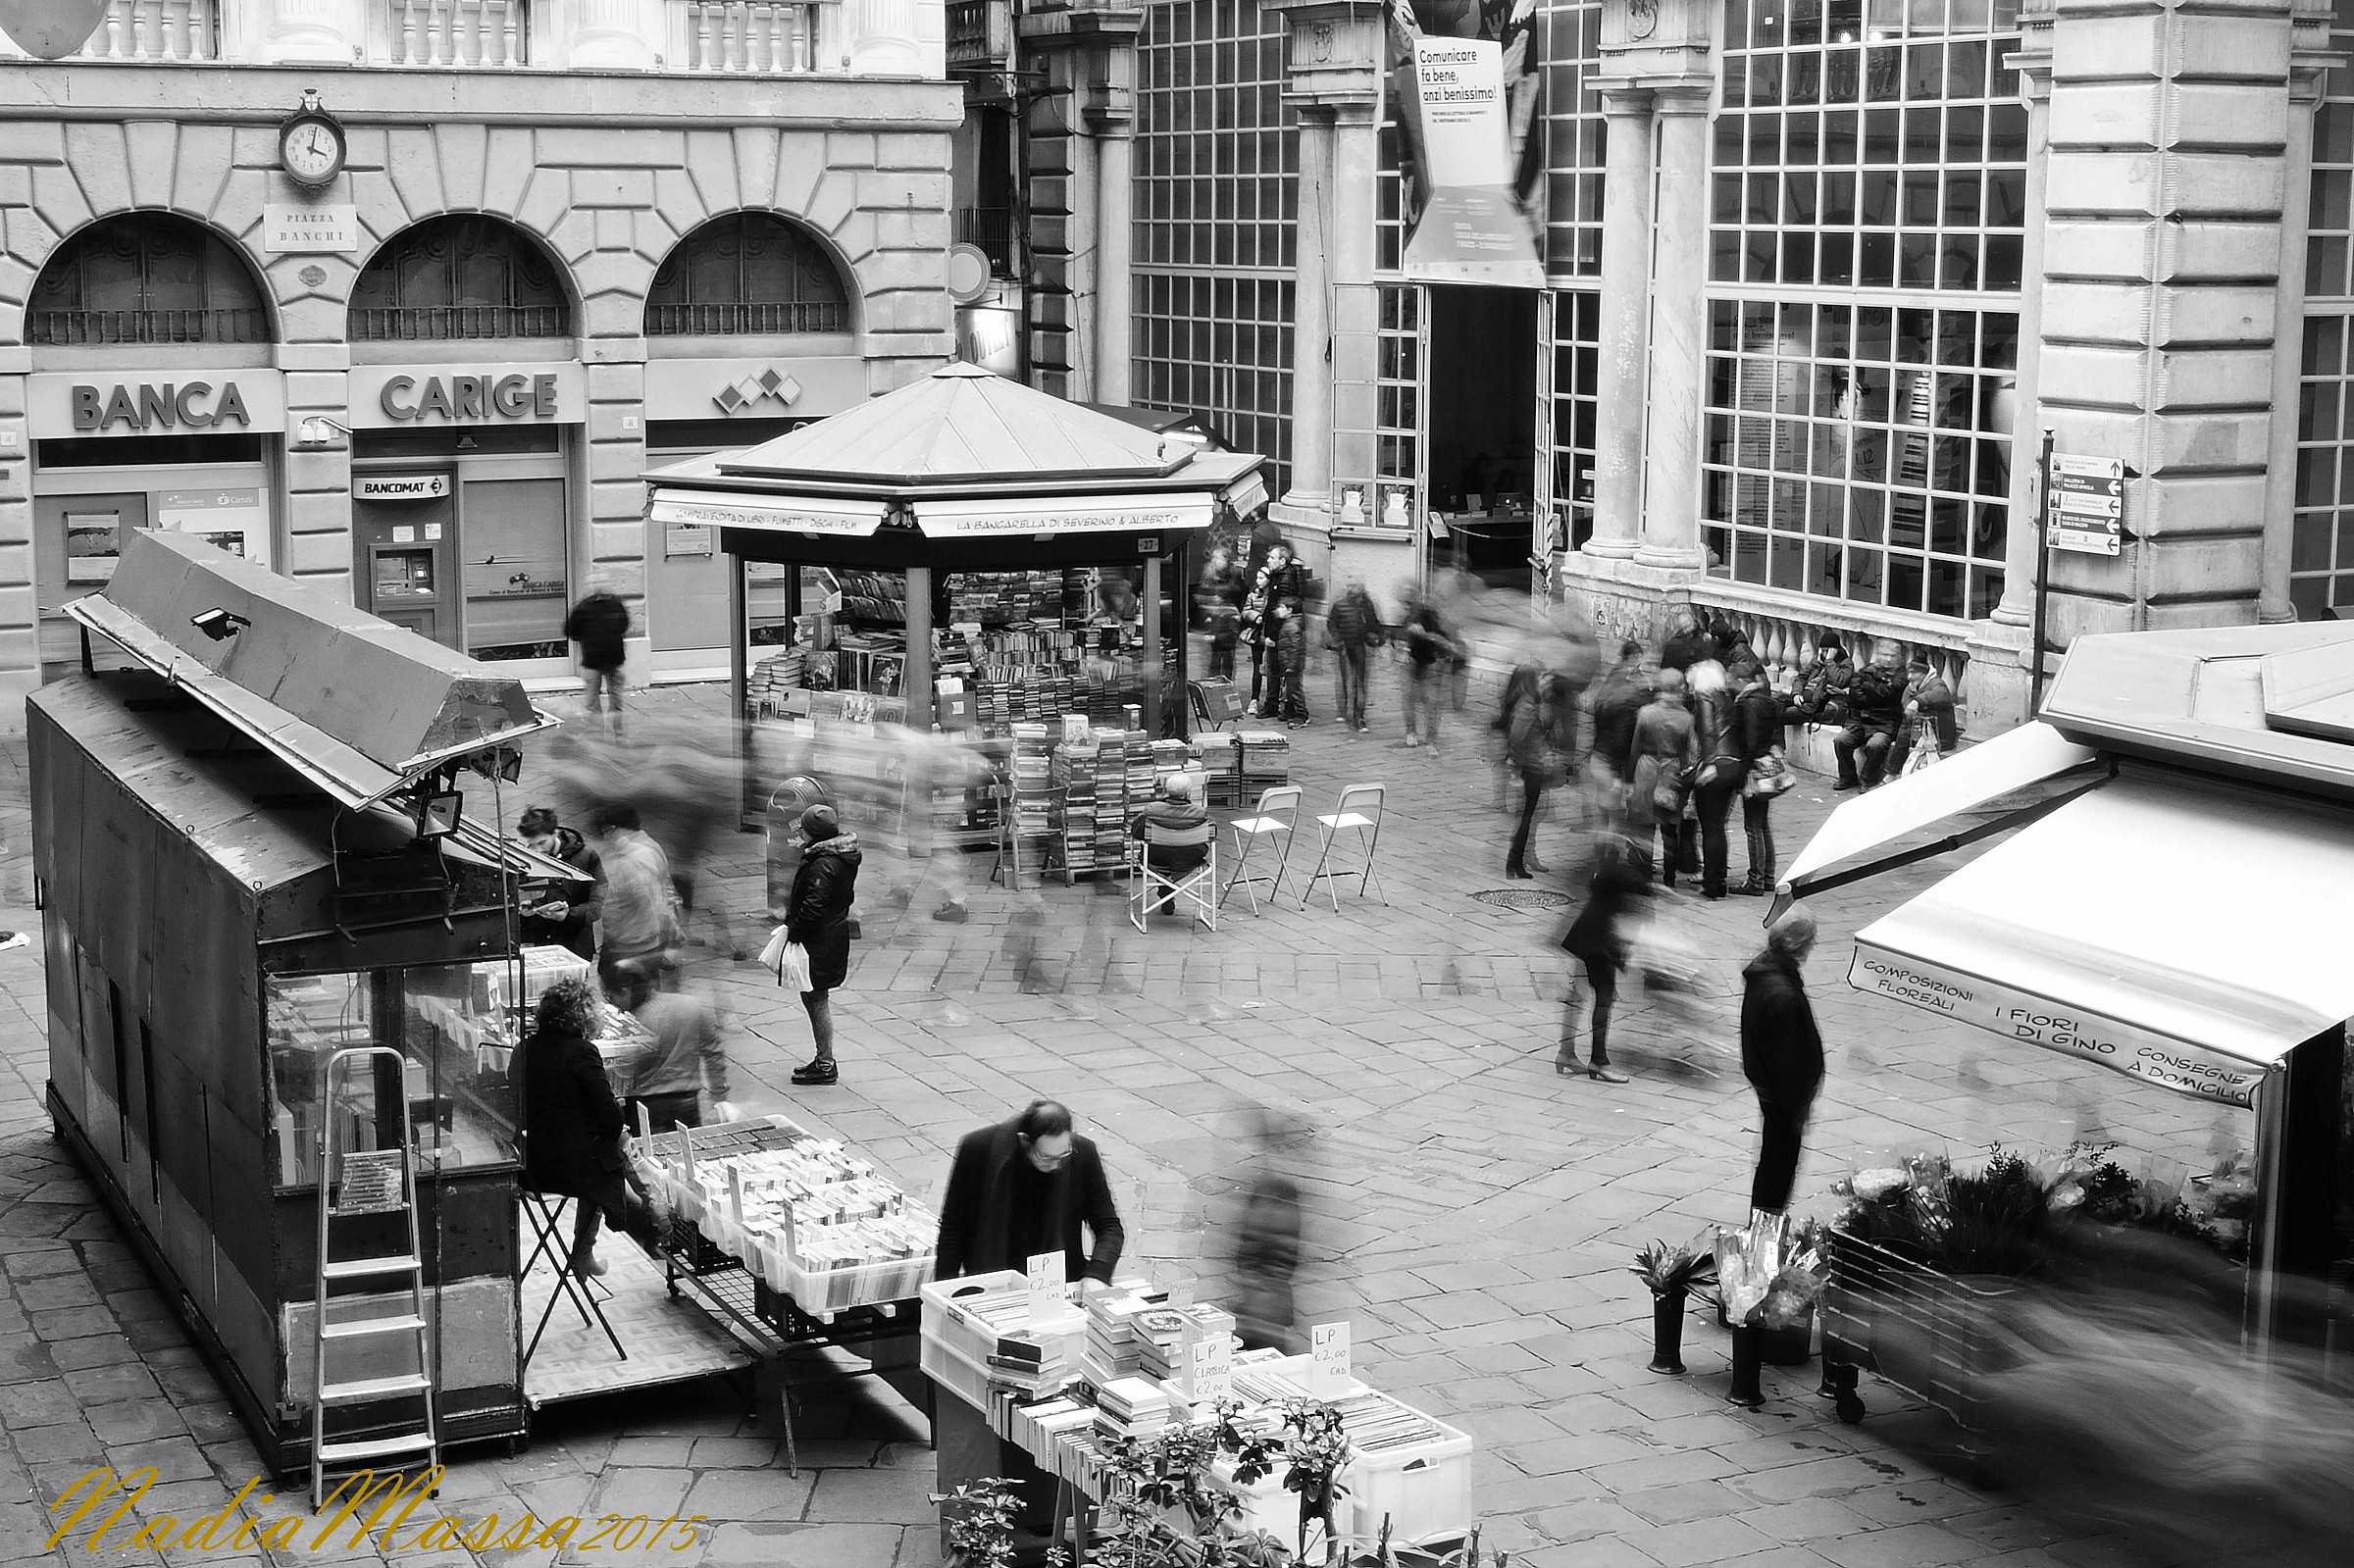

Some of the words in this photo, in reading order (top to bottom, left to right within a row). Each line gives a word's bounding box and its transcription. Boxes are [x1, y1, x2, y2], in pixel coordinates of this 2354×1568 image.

[1419, 47, 1477, 64] Comunicare
[1421, 68, 1431, 82] fa
[1432, 68, 1458, 83] bene,
[1423, 86, 1442, 101] anzi
[1444, 84, 1498, 100] benissimo!
[286, 214, 334, 223] PIAZZA
[280, 231, 343, 241] BANCHI
[72, 380, 252, 430] BANCA
[380, 374, 559, 420] CARIGE
[364, 481, 426, 493] BANCOMAT
[956, 521, 970, 530] LA
[974, 518, 1046, 531] BANCARELLA
[1049, 519, 1060, 528] DI
[1062, 517, 1115, 528] SEVERINO
[1118, 516, 1126, 526] &
[1129, 514, 1179, 525] ALBERTO
[1864, 960, 1973, 1002] COMPOSIZIONI
[1877, 979, 1955, 1011] FLOREALI
[1994, 1006, 2001, 1018] I
[2010, 1008, 2079, 1033] FIORI
[2014, 1024, 2041, 1040] DI
[2051, 1033, 2117, 1055] GINO
[2136, 1046, 2248, 1085] CONSEGNE
[2126, 1060, 2142, 1074] A
[2148, 1066, 2248, 1102] DOMICILIO
[1194, 1364, 1230, 1380] CLASSICA
